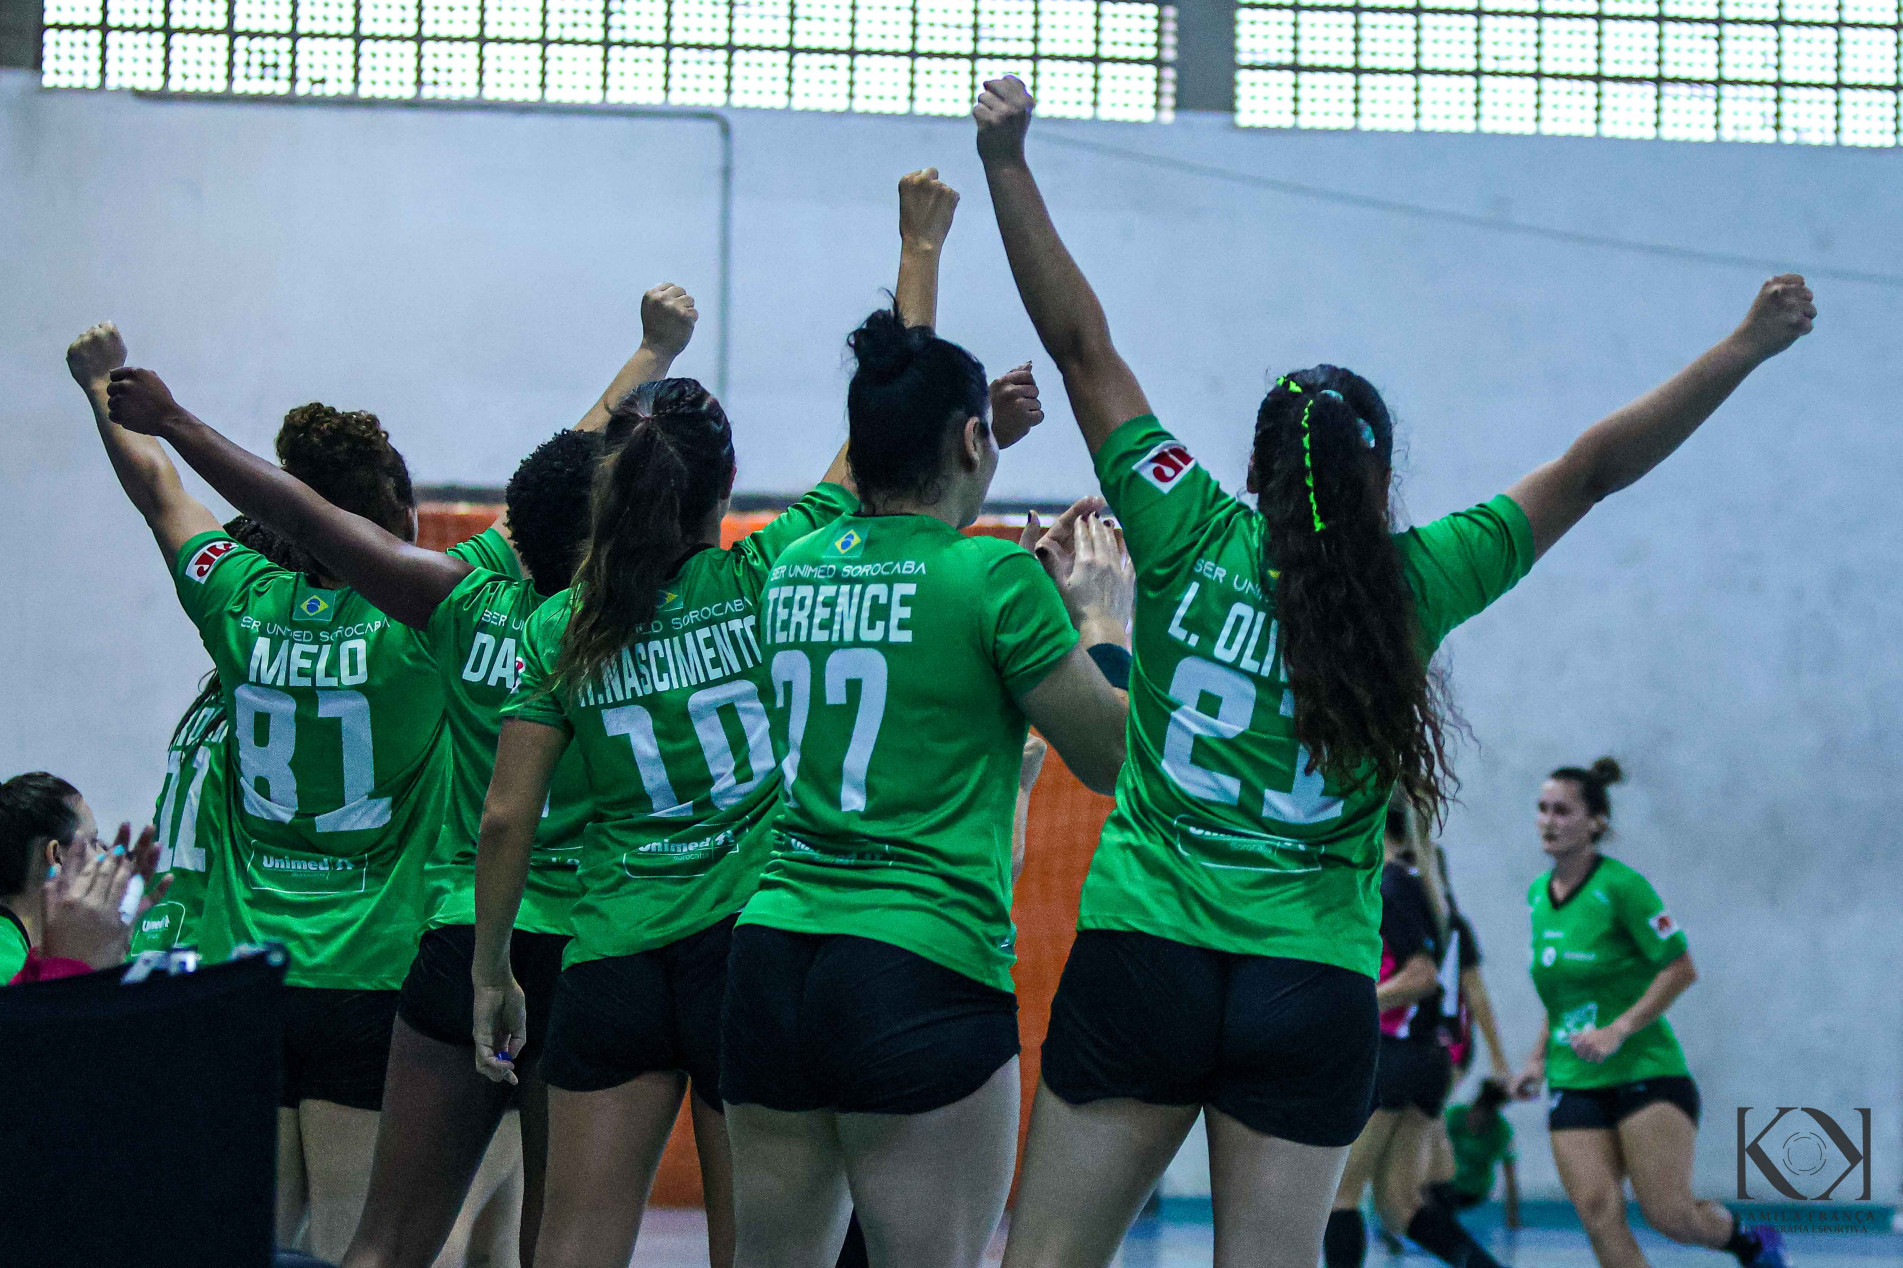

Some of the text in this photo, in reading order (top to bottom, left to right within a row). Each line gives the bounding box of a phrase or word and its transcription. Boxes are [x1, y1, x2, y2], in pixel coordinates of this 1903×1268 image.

[788, 564, 836, 579] UNIMED
[841, 560, 927, 578] SOROCABA
[1193, 559, 1227, 584] SER
[766, 582, 917, 645] TERENCE
[1167, 581, 1288, 683] L. OLI
[248, 636, 368, 687] MELO
[235, 684, 393, 833] 81
[601, 679, 777, 818] 10
[771, 647, 888, 812] 77
[262, 855, 330, 872] Unimed
